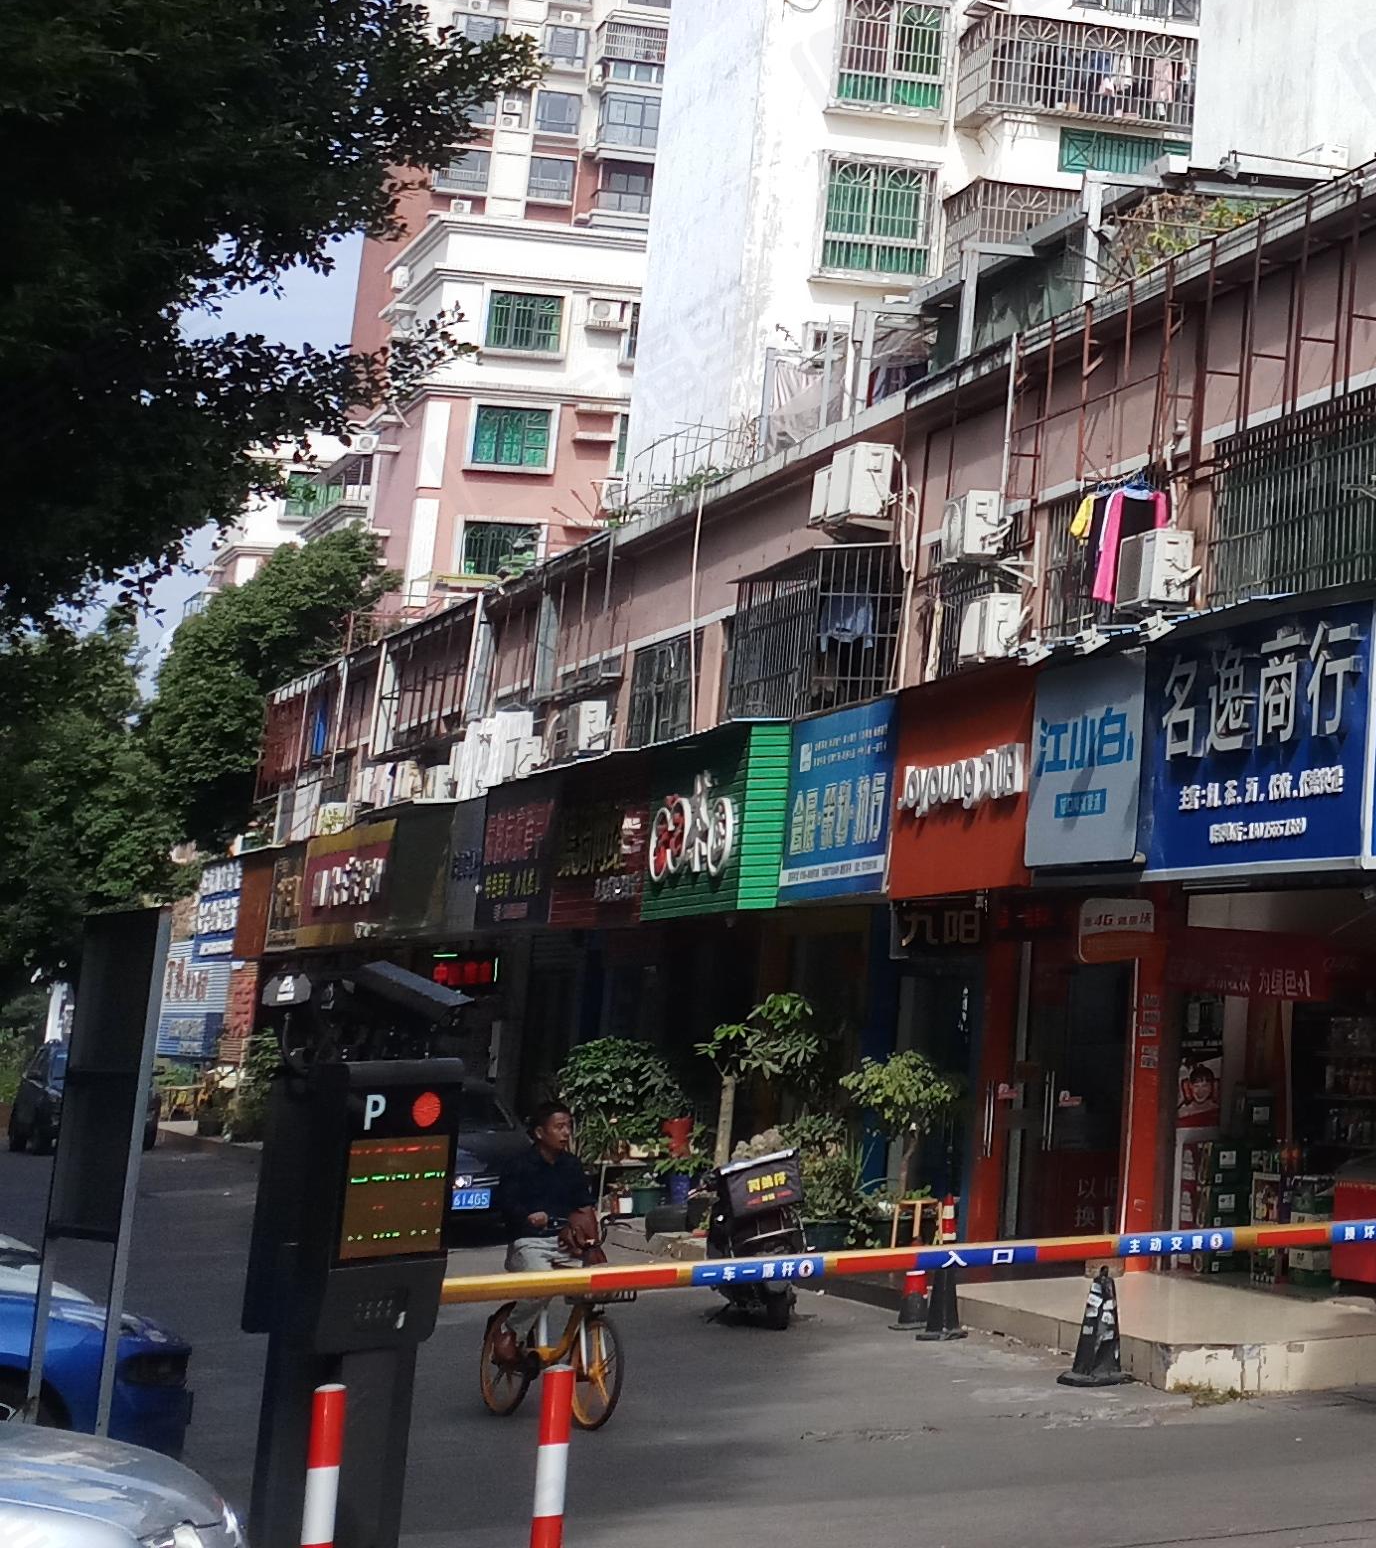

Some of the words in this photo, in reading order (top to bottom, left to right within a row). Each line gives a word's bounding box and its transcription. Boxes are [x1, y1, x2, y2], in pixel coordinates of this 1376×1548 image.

[1162, 621, 1366, 760] 名逸商行
[1036, 707, 1127, 777] 江小白
[897, 758, 977, 817] Joyoung
[902, 911, 980, 947] 九阳
[364, 1094, 386, 1130] P
[941, 1247, 1015, 1269] 入口
